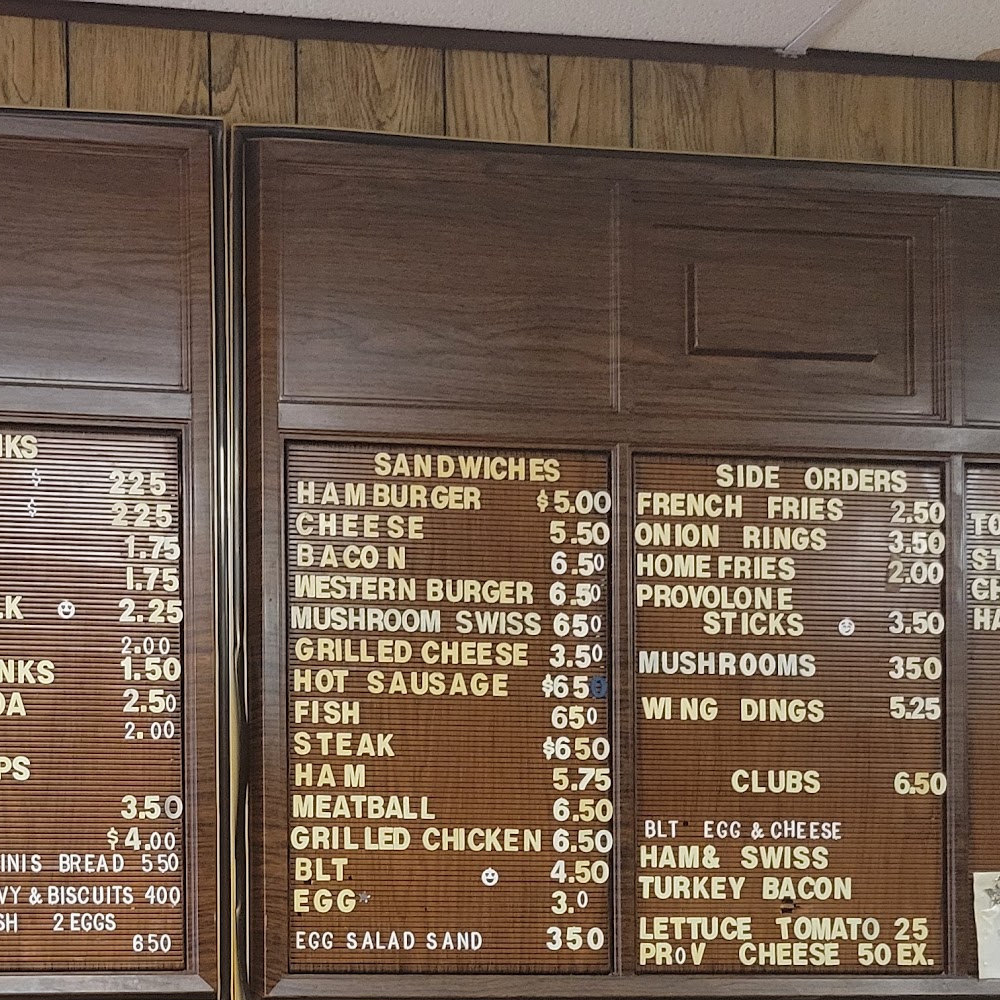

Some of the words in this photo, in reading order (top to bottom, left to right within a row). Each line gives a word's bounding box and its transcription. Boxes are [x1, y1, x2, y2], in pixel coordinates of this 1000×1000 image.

[374, 452, 561, 482] SANDWICHES
[716, 464, 780, 488] SIDE
[804, 467, 907, 493] ORDERS
[297, 481, 481, 510] HAMBURGER
[637, 492, 743, 518] FRENCH
[768, 496, 843, 521] FRIES
[635, 523, 719, 547] ONION
[743, 526, 827, 551] RINGS
[888, 530, 945, 555] 3.50
[294, 574, 416, 601] WESTERN
[427, 580, 533, 605] BURGER
[636, 584, 793, 611] PROVOLONE
[290, 606, 441, 633] MUSHROOM
[456, 610, 542, 636] SWISS
[703, 611, 803, 637] STICKS
[295, 638, 412, 664] GRILLED
[120, 657, 181, 681] 1.50
[638, 651, 816, 678] MUSHROOMS
[294, 701, 360, 725] FISH
[741, 698, 825, 723] DINGS
[294, 732, 395, 756] STEAK
[731, 769, 821, 794] CLUBS
[894, 772, 947, 796] 6.50
[292, 795, 436, 819] MEATBALL
[290, 826, 411, 850] GRILLED
[422, 827, 541, 852] CHICKEN
[59, 854, 125, 873] BREAD
[295, 858, 348, 881] BLT
[740, 846, 829, 870] SWISS
[48, 886, 134, 905] BISCUITS
[638, 877, 745, 900] TURKEY
[70, 913, 116, 931] EGGS
[639, 917, 752, 940] LETTUCE
[776, 917, 880, 940] TOMATO
[346, 931, 415, 950] SALAD
[426, 931, 483, 950] SAND
